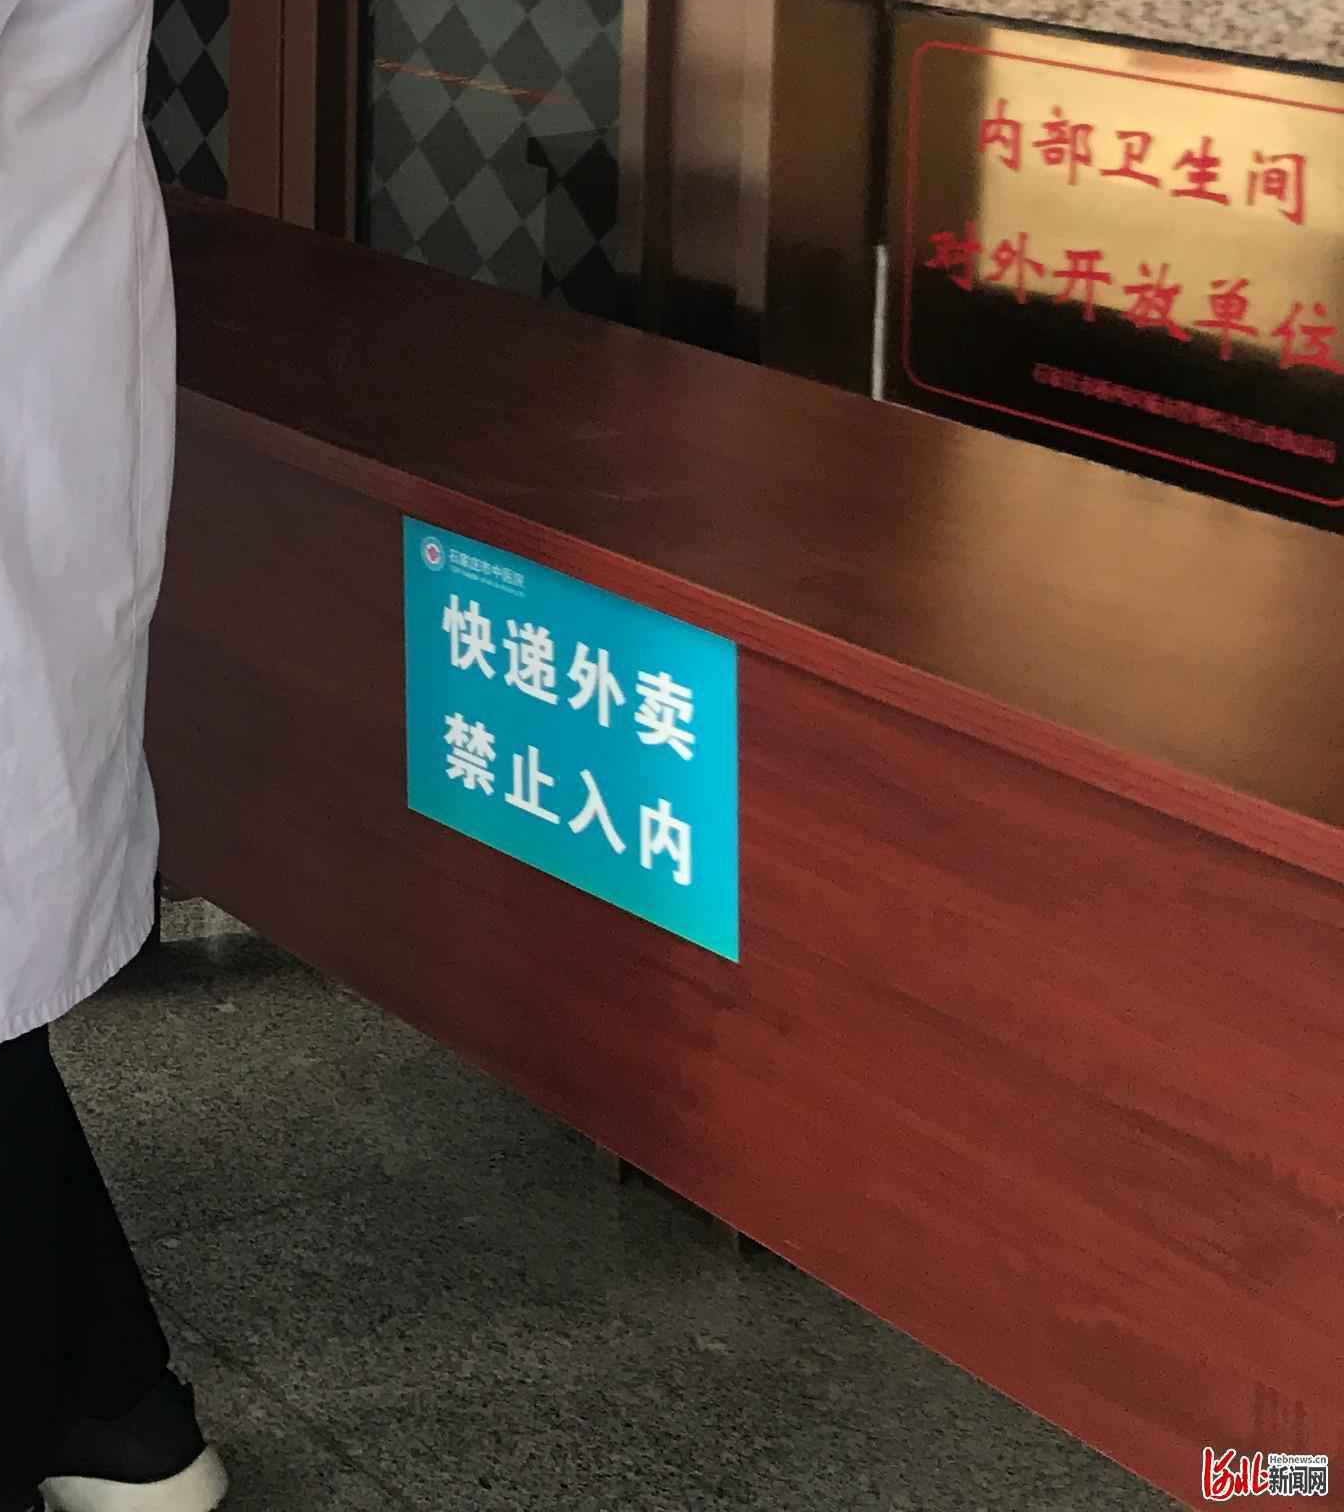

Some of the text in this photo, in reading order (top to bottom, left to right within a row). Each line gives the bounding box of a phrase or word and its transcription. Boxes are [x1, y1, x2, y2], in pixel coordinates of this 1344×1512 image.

[977, 97, 1307, 225] 内部卫生间
[924, 219, 1344, 375] 对外开放单位
[441, 593, 698, 762] 快递外卖
[443, 711, 694, 887] 禁止入内
